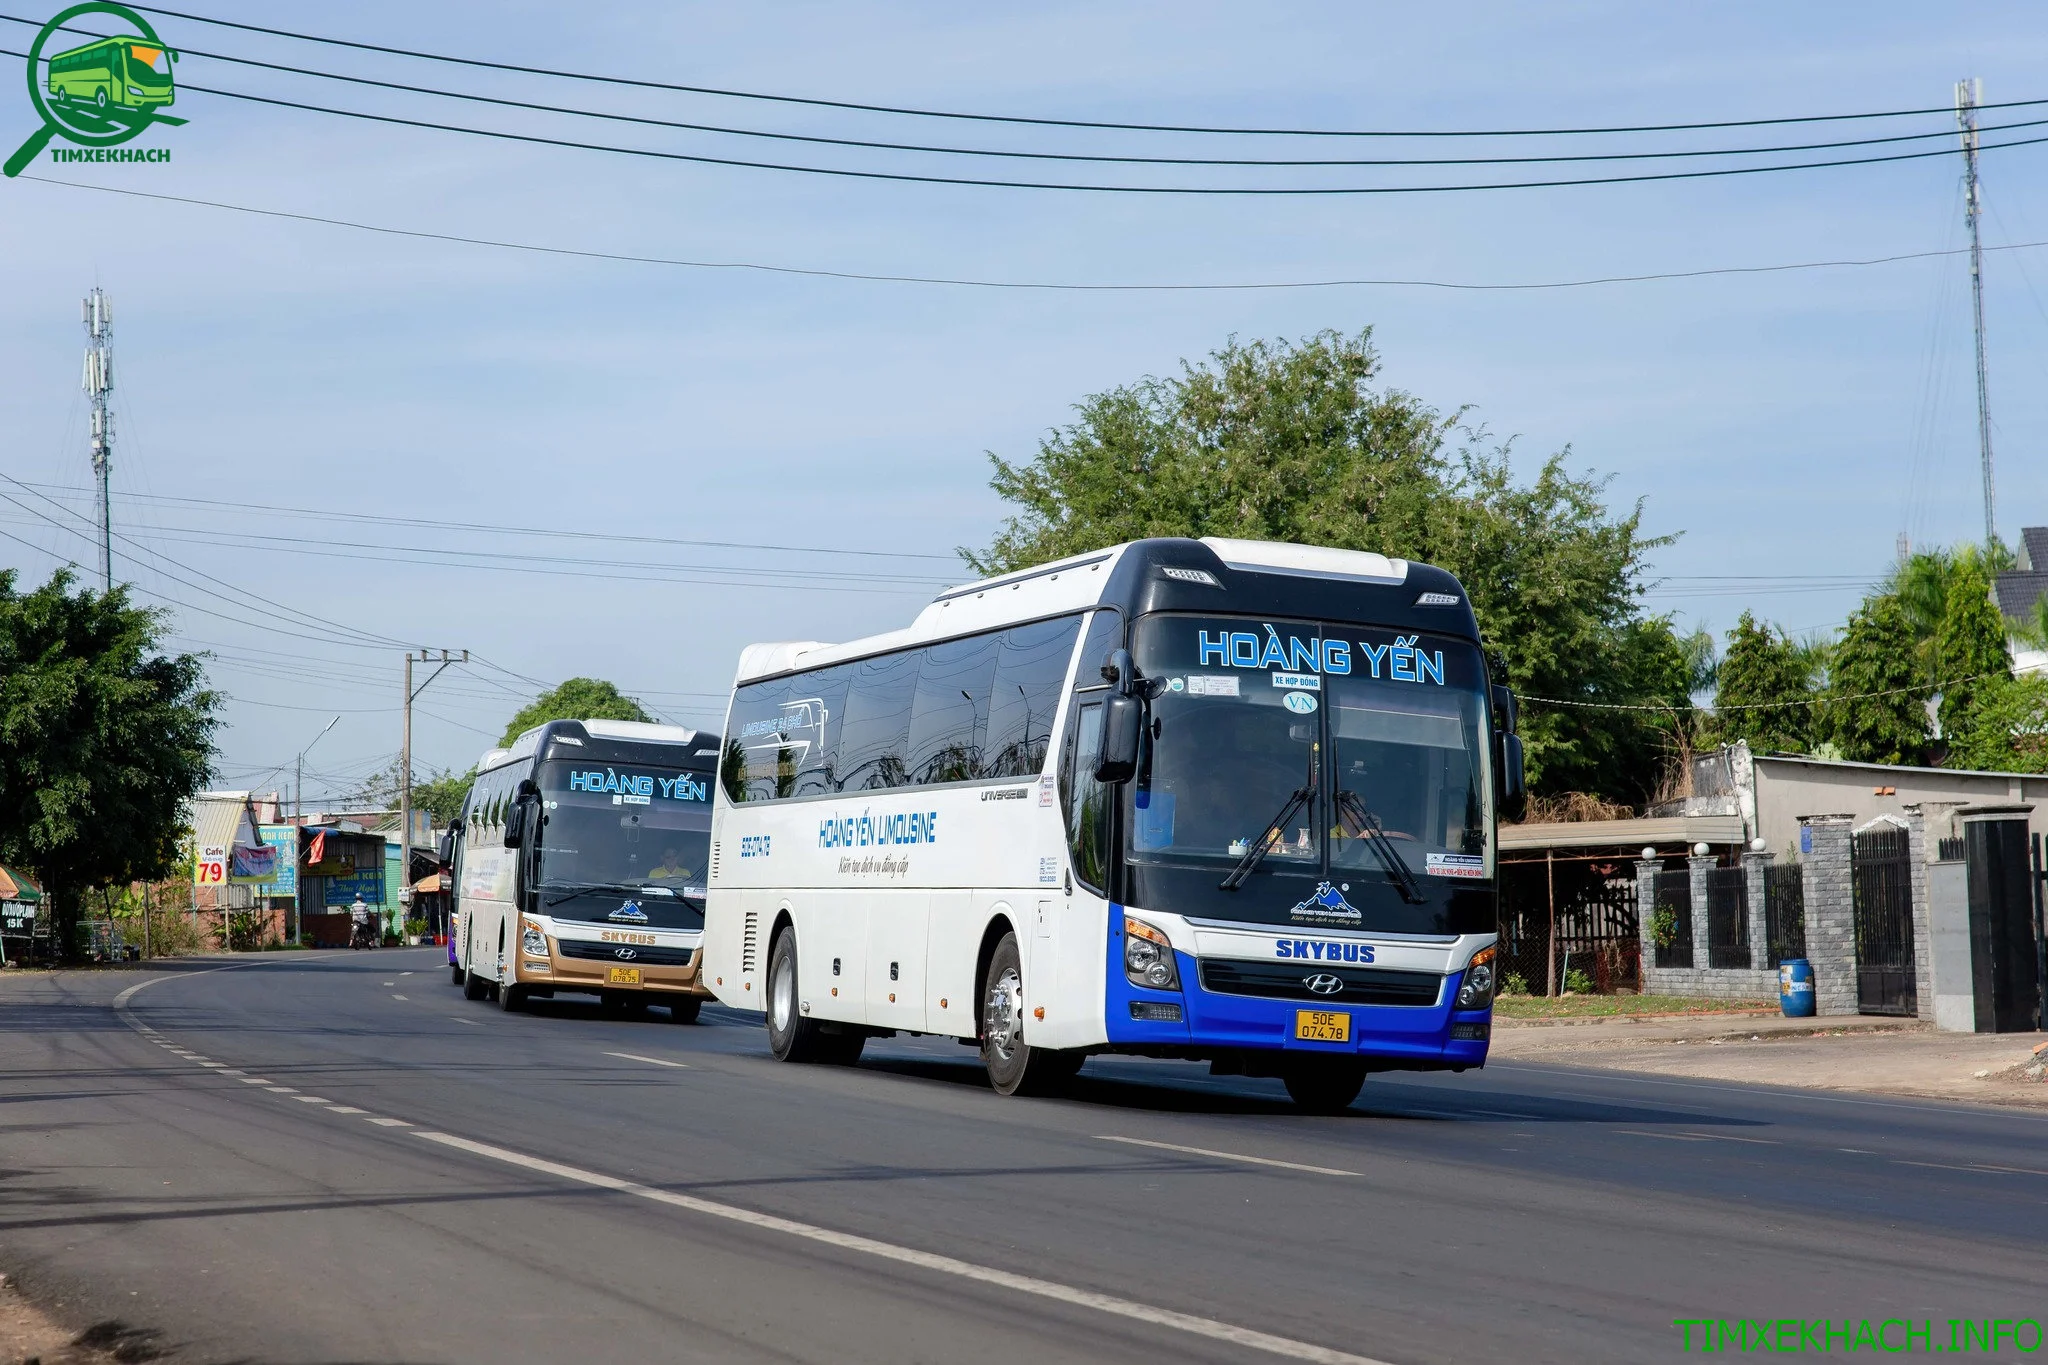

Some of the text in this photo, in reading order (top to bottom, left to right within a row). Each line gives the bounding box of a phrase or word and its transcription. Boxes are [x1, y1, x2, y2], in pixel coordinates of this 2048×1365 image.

[1199, 623, 1445, 686] HOÀNG YẾN
[1275, 676, 1284, 684] XE
[1287, 695, 1313, 711] VN
[570, 768, 706, 801] HOÀNG YẾN
[819, 806, 937, 848] HOÀNG YẾN LIMOUSINE
[205, 847, 224, 856] Cafe
[198, 862, 222, 882] 79
[601, 931, 656, 945] SKYBUS
[1276, 939, 1375, 964] SKYBUS
[618, 968, 632, 976] 50E
[1312, 1013, 1335, 1026] 50E
[1302, 1025, 1343, 1040] 074.78
